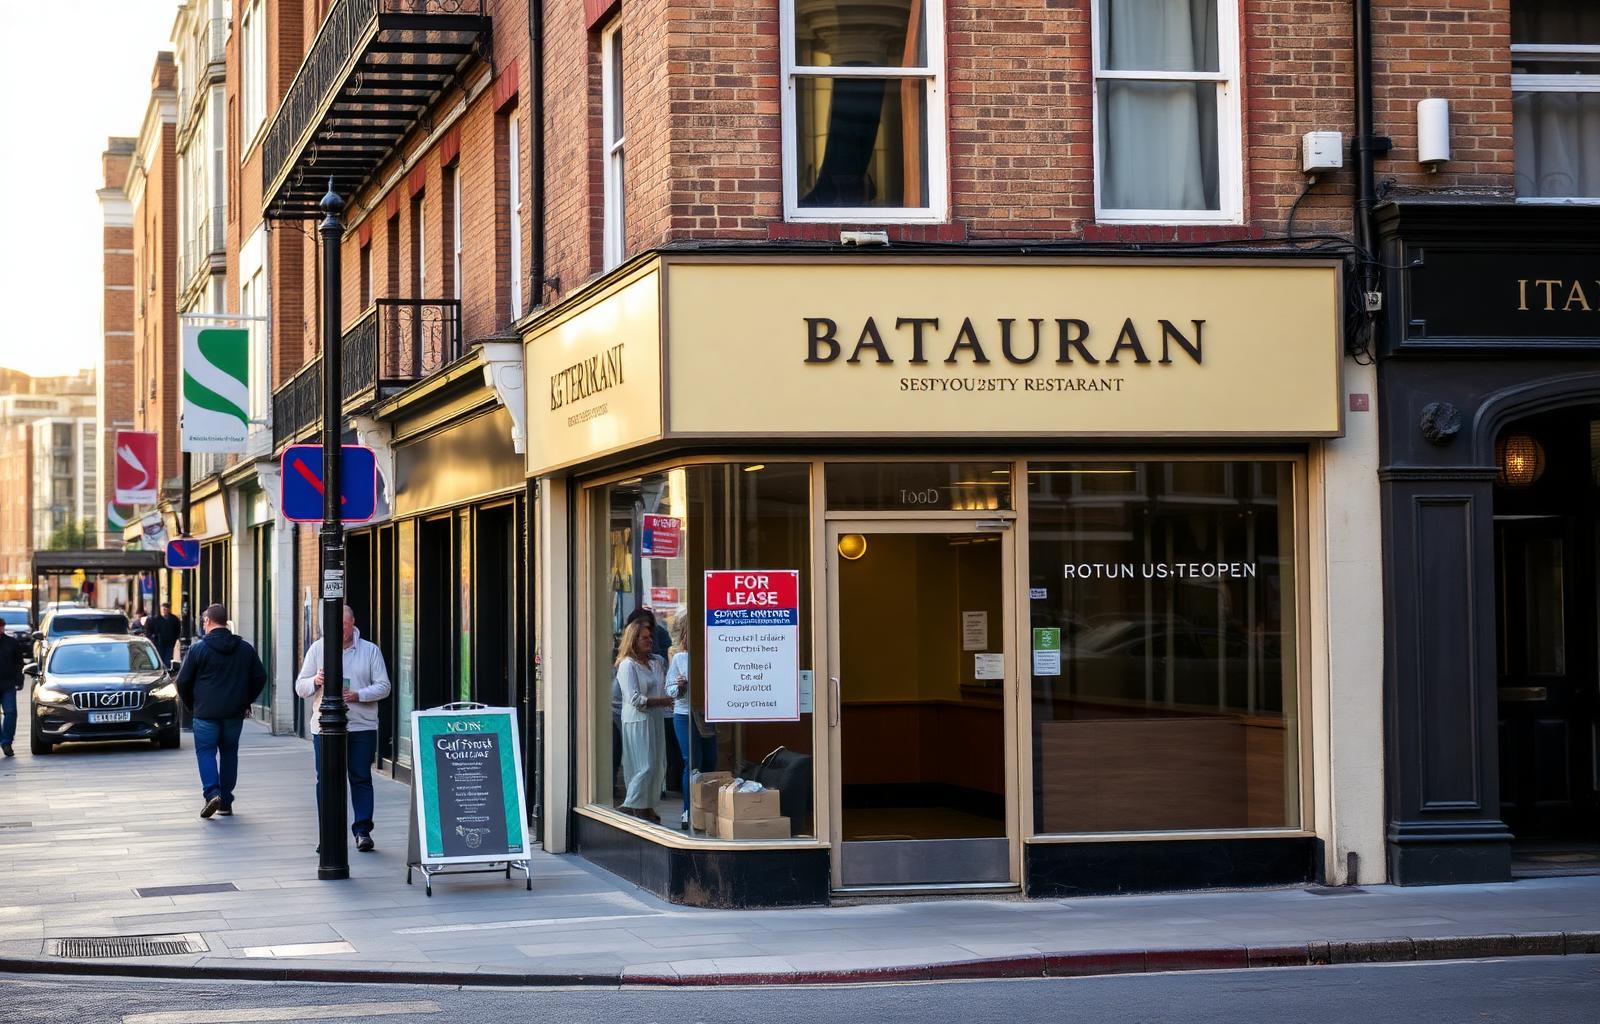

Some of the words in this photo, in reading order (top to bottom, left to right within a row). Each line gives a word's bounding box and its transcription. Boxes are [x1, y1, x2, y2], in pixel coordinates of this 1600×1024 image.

[1517, 279, 1600, 312] ITA
[803, 316, 1207, 367] BATAURAN
[1024, 378, 1124, 391] RESTARANT
[1064, 563, 1134, 579] ROTUN
[734, 575, 769, 590] FOR
[726, 591, 779, 606] LEASE
